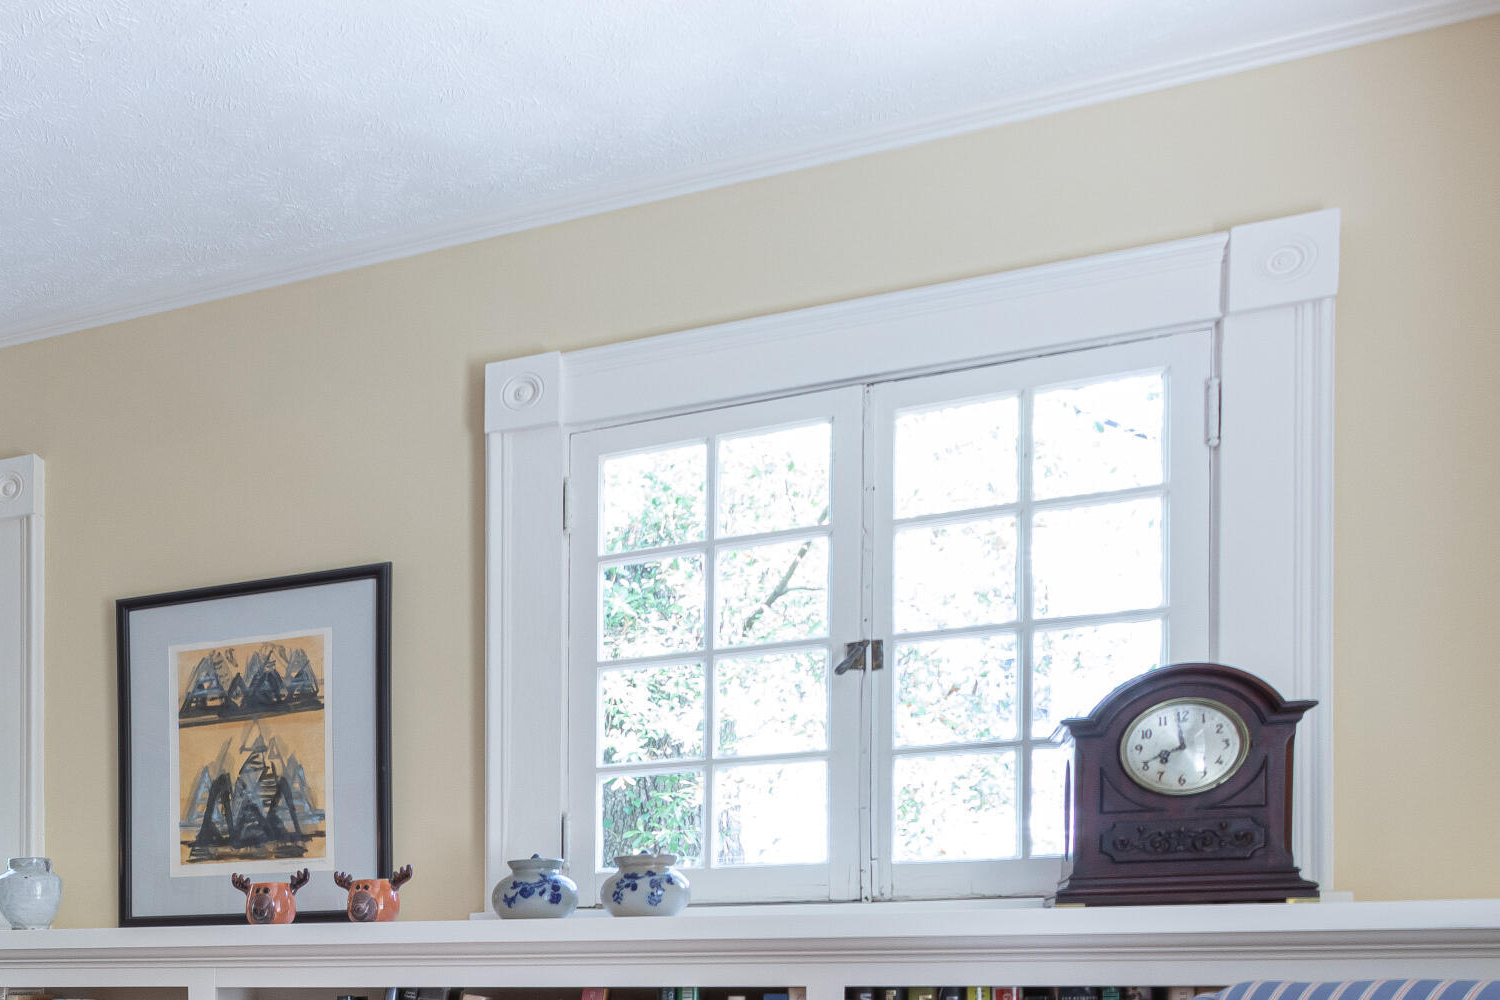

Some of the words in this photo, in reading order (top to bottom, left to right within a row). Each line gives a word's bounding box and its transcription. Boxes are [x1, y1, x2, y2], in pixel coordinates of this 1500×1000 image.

[1158, 716, 1167, 727] 11
[1201, 713, 1206, 724] 1
[1141, 728, 1152, 740] 10
[1216, 723, 1223, 734] 2
[1135, 744, 1143, 754] 9
[1223, 739, 1230, 749] 3
[1215, 754, 1224, 765] 4
[1142, 760, 1150, 772] 8
[1157, 771, 1164, 782] 7
[1178, 774, 1186, 786] 6
